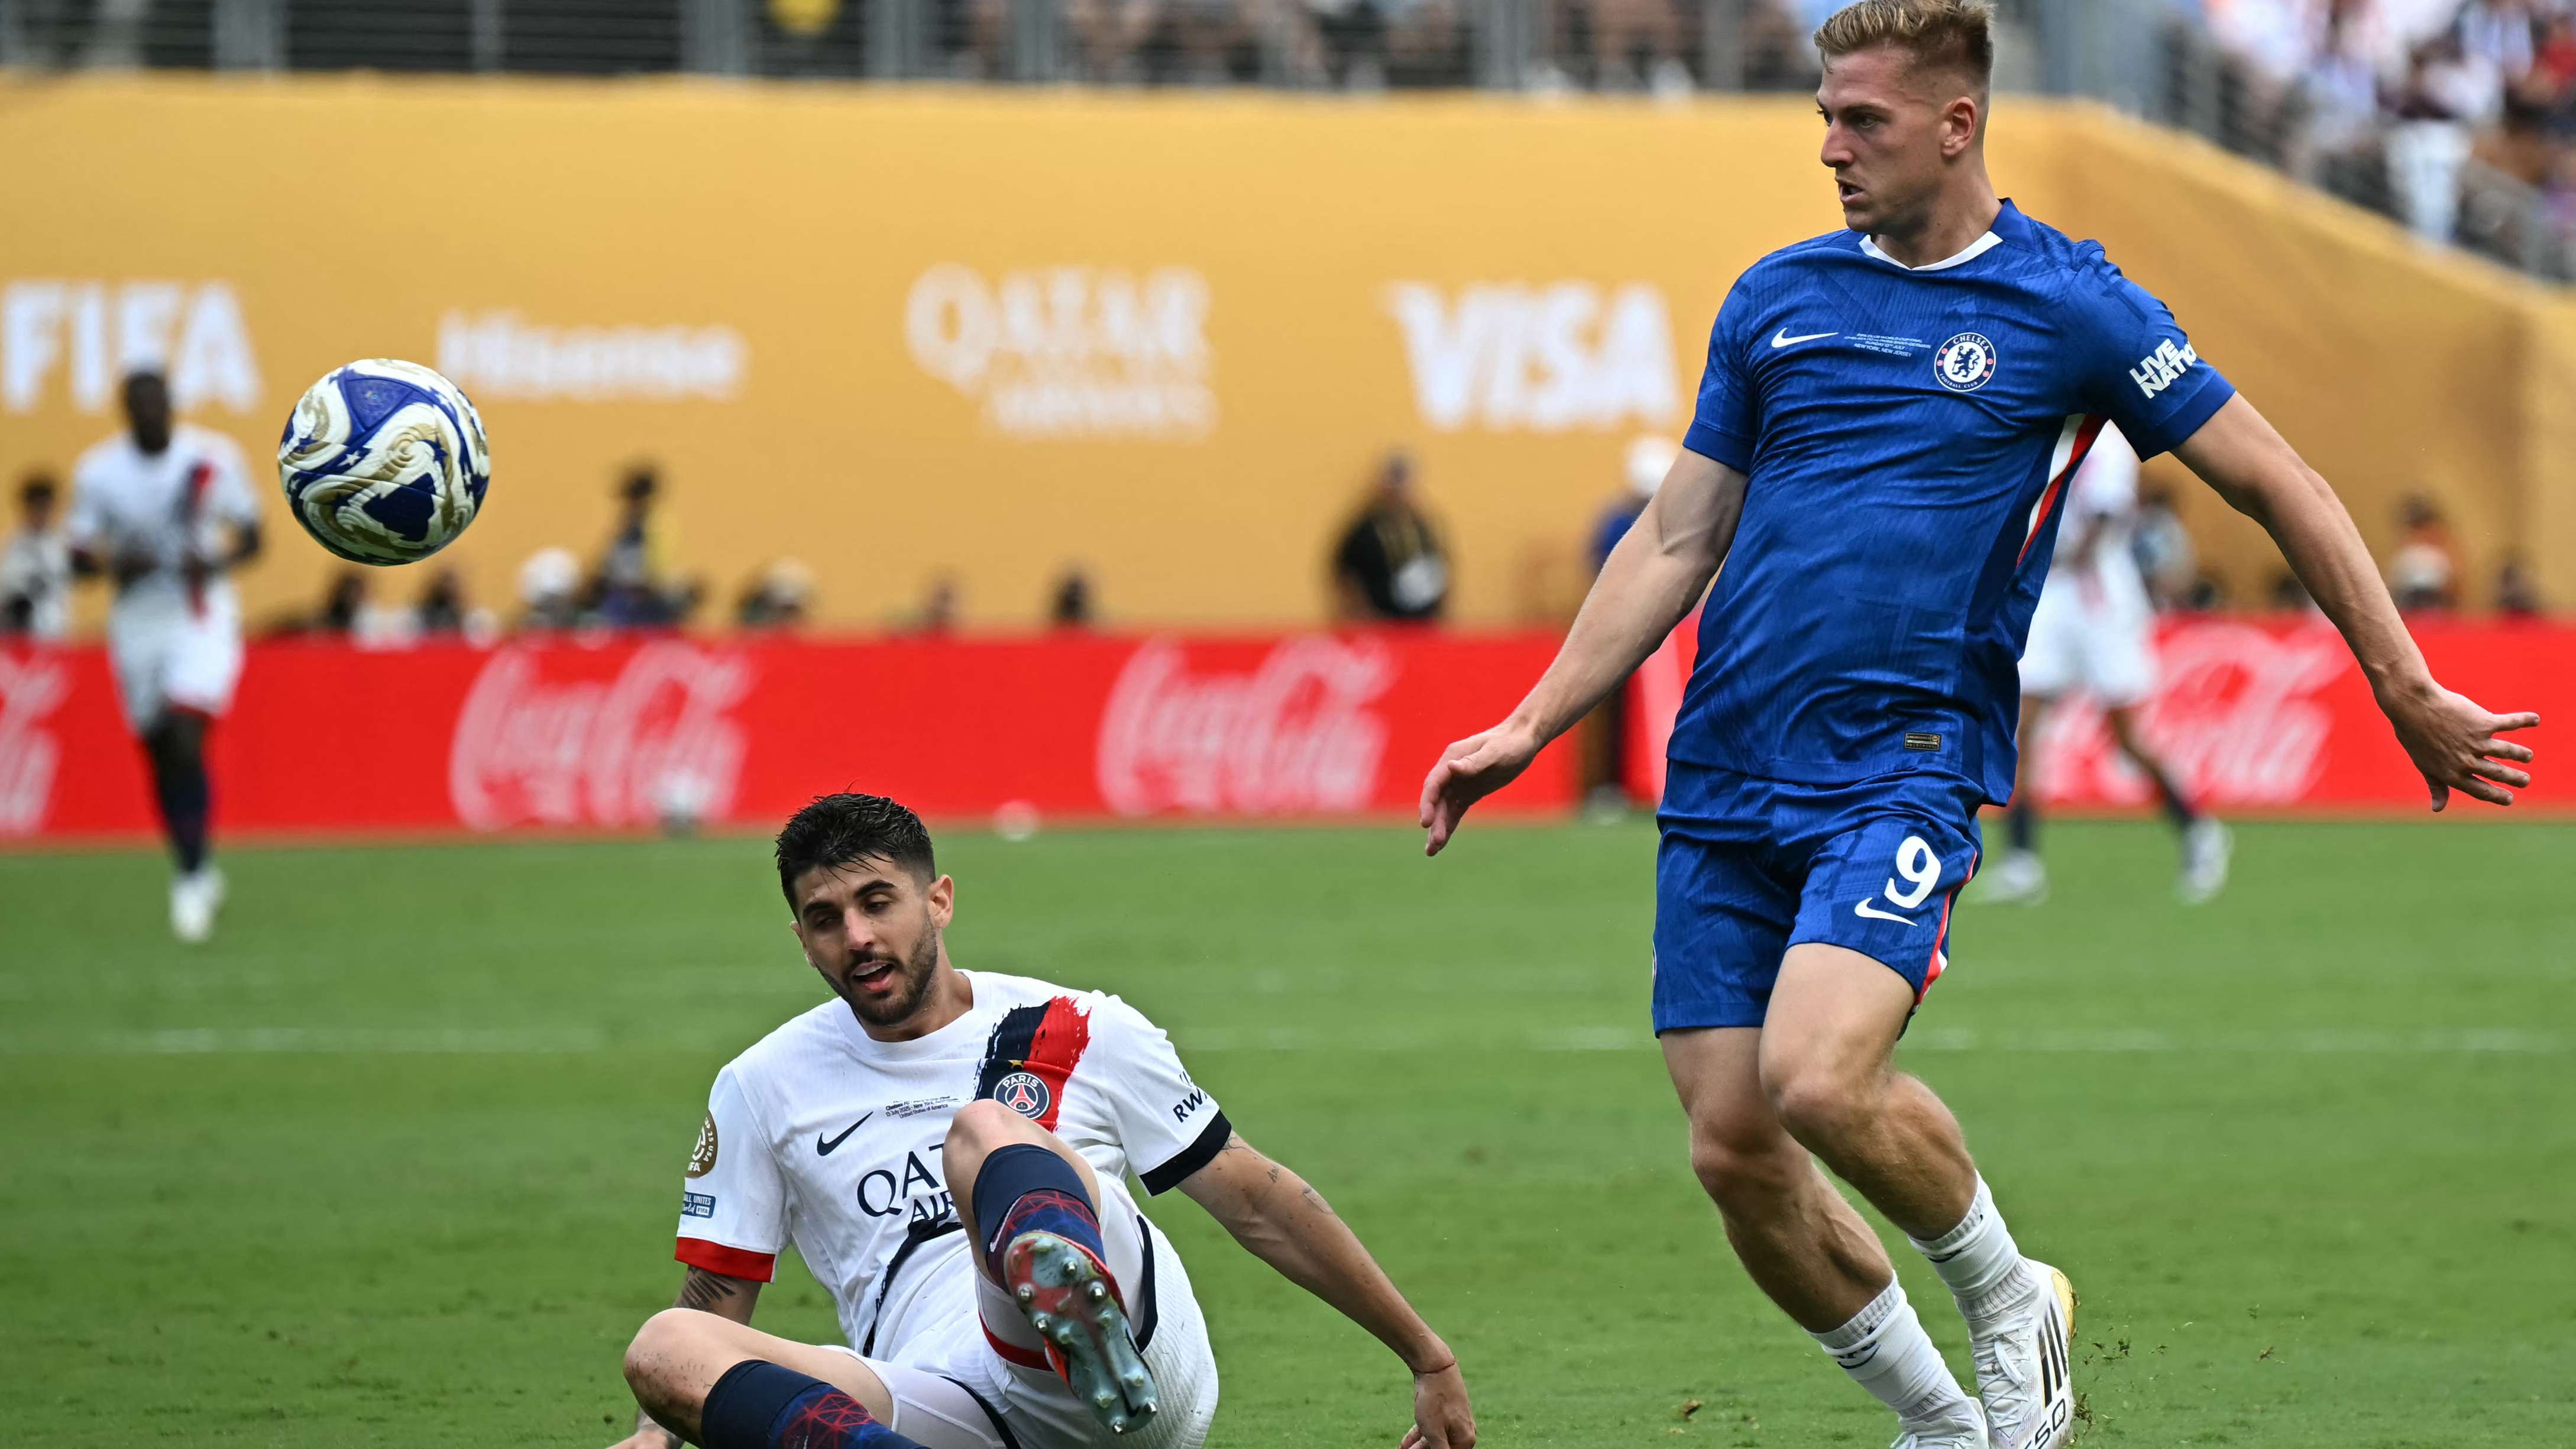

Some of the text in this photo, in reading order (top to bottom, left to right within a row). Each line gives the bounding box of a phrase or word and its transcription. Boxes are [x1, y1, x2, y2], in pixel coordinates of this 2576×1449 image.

[4, 279, 260, 413] FIFA
[1387, 282, 1678, 425] VISA
[1953, 335, 1989, 351] CHELSEA
[2129, 338, 2180, 385] LIVE
[2140, 341, 2198, 399] NATIO
[1884, 835, 1941, 909] 9
[1002, 1075, 1039, 1088] PARIS
[703, 1145, 714, 1162] USA
[708, 1131, 714, 1142] 25
[693, 1195, 711, 1205] UNITES
[2024, 1398, 2066, 1449] 50
